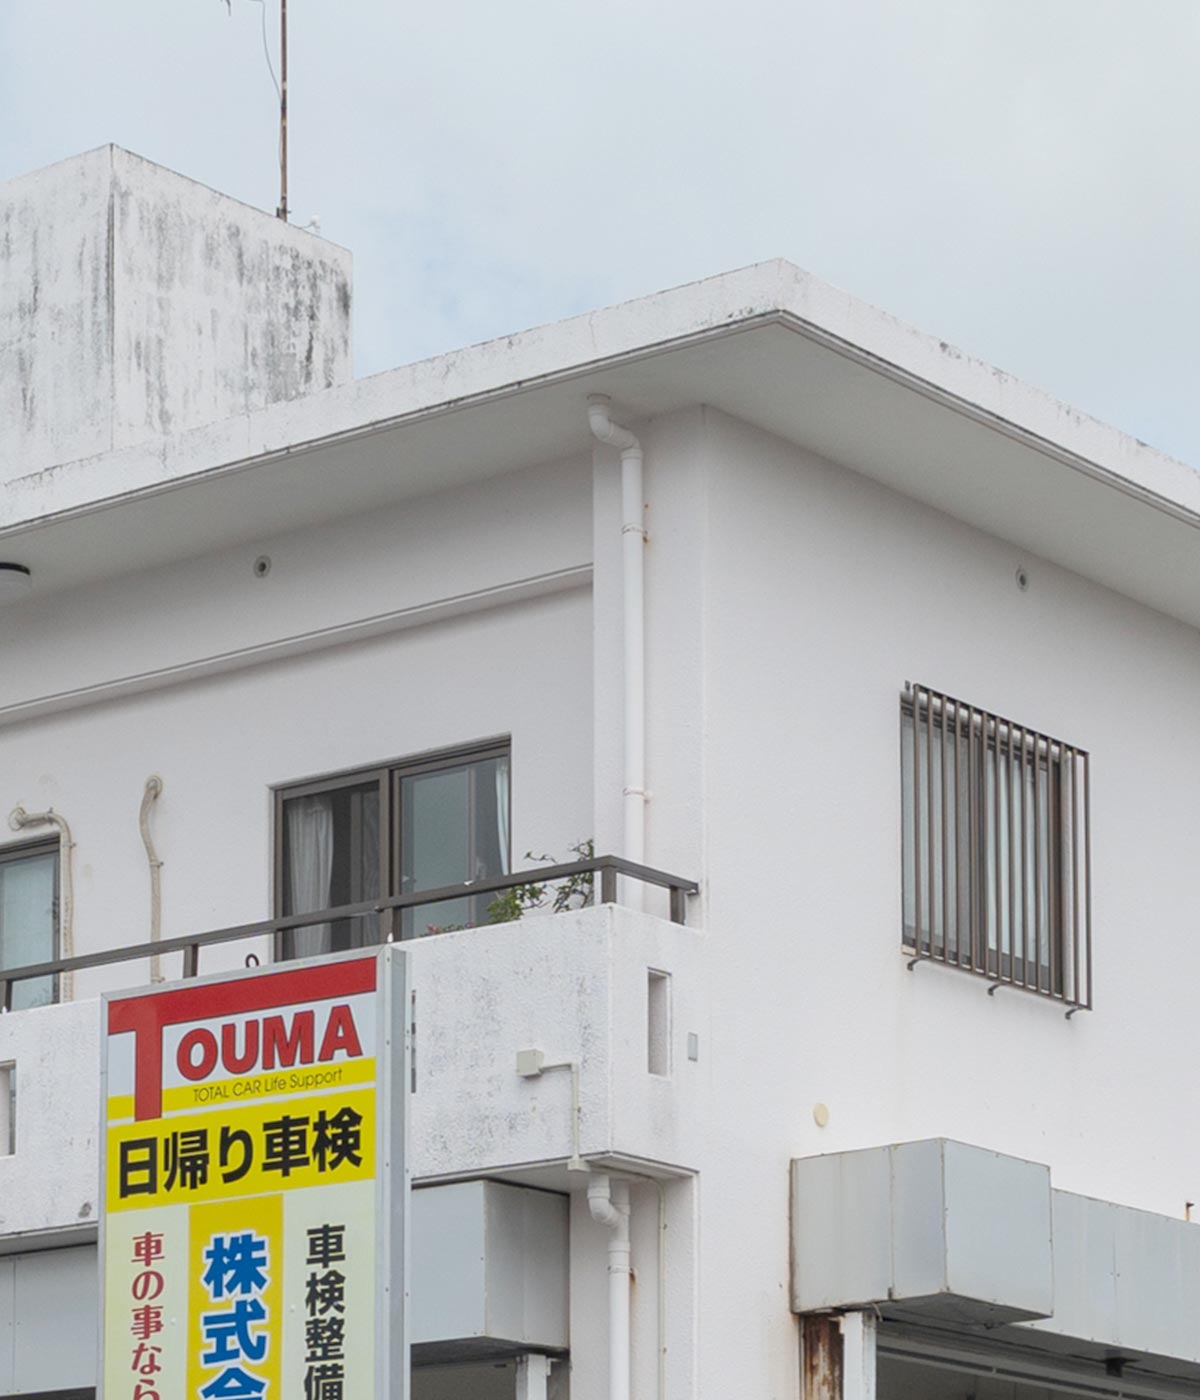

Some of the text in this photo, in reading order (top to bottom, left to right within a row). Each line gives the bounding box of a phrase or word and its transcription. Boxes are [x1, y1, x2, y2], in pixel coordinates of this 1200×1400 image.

[107, 956, 377, 1122] TOUMA
[193, 1067, 344, 1102] TOTAL CAR Life Support
[119, 1106, 363, 1199] 日帰り車検
